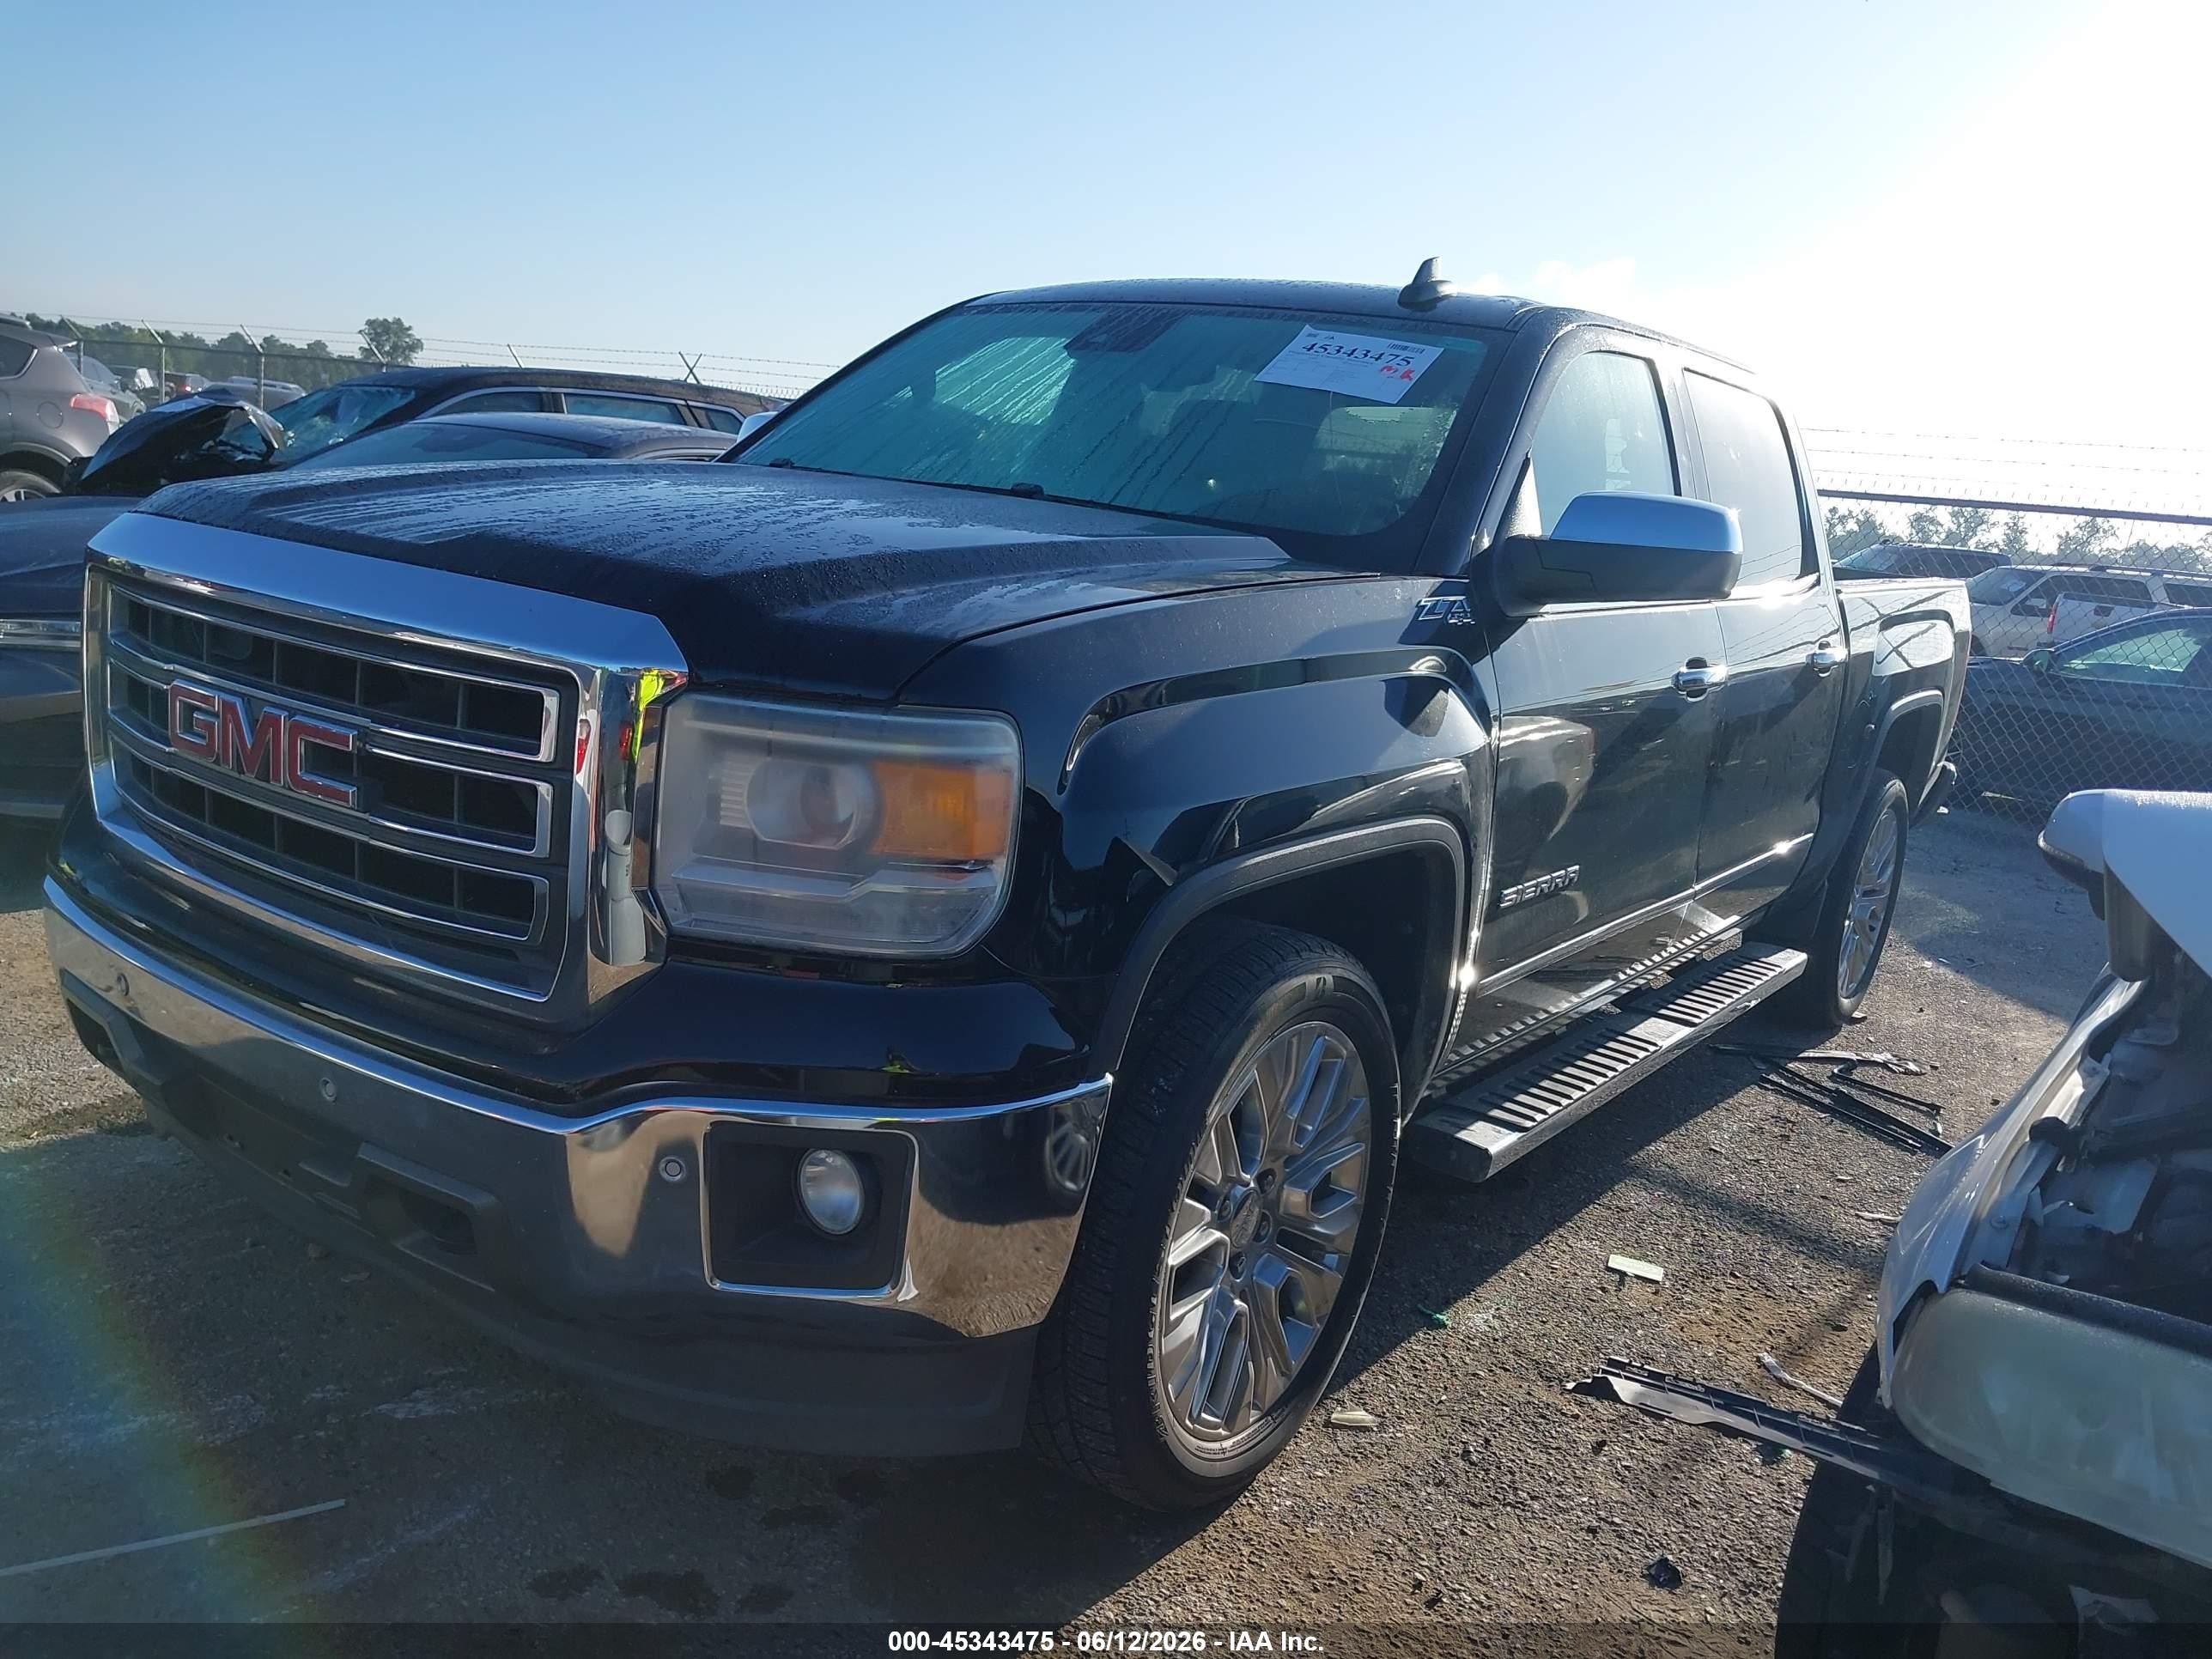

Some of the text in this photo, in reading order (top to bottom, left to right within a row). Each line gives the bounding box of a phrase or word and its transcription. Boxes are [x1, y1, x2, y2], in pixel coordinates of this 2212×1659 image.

[1302, 342, 1415, 367] 45343475
[168, 678, 357, 810] GMC
[1498, 865, 1580, 908] SIERRA
